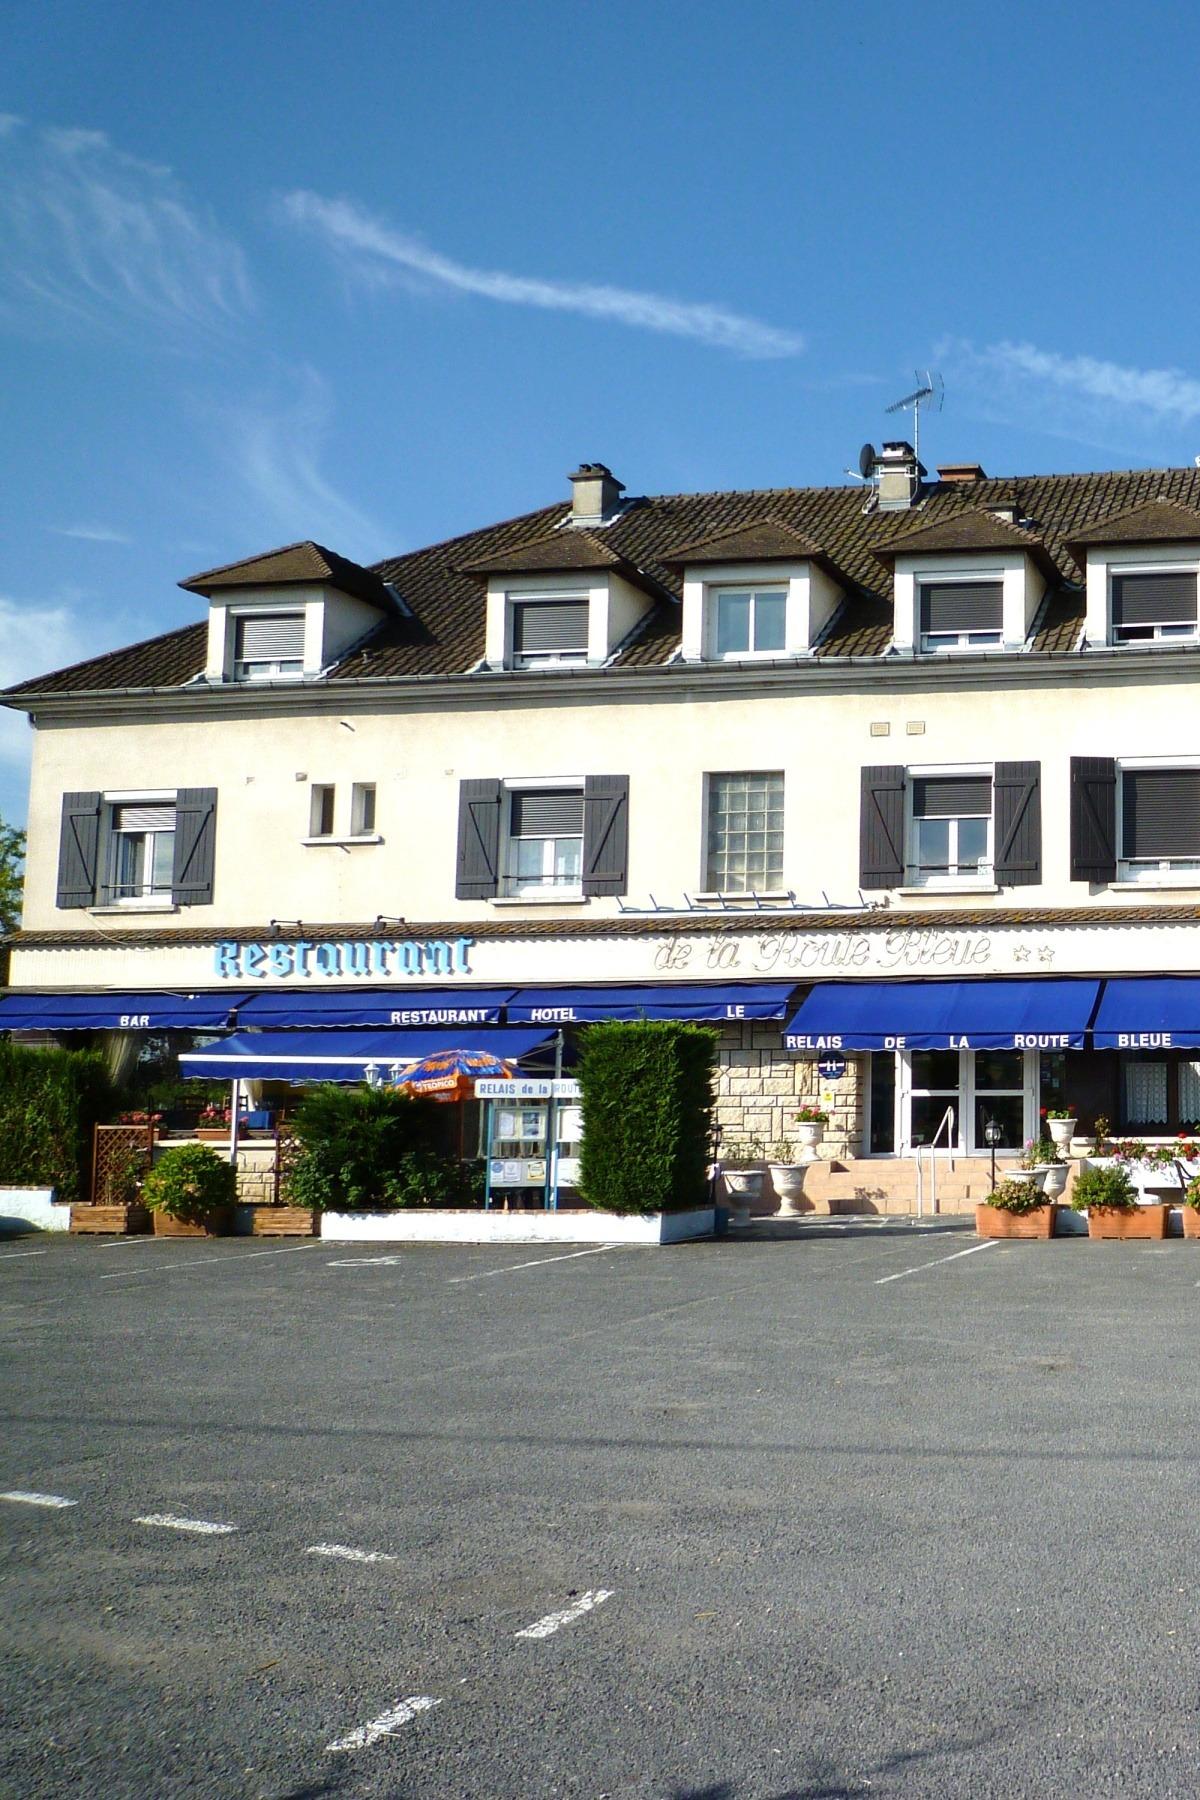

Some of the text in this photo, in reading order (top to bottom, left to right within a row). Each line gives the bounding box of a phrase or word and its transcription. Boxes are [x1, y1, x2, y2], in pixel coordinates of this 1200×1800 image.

[213, 937, 475, 979] Restaurant
[391, 1010, 488, 1024] RESTAURANT
[531, 1005, 745, 1020] HOTEL LE
[120, 1015, 149, 1027] BAR
[786, 1034, 1070, 1049] RELAIS DE LA ROUTE
[1118, 1034, 1172, 1047] BLEUE
[480, 1083, 516, 1093] RELAIS
[521, 1083, 533, 1093] de
[539, 1083, 549, 1093] la
